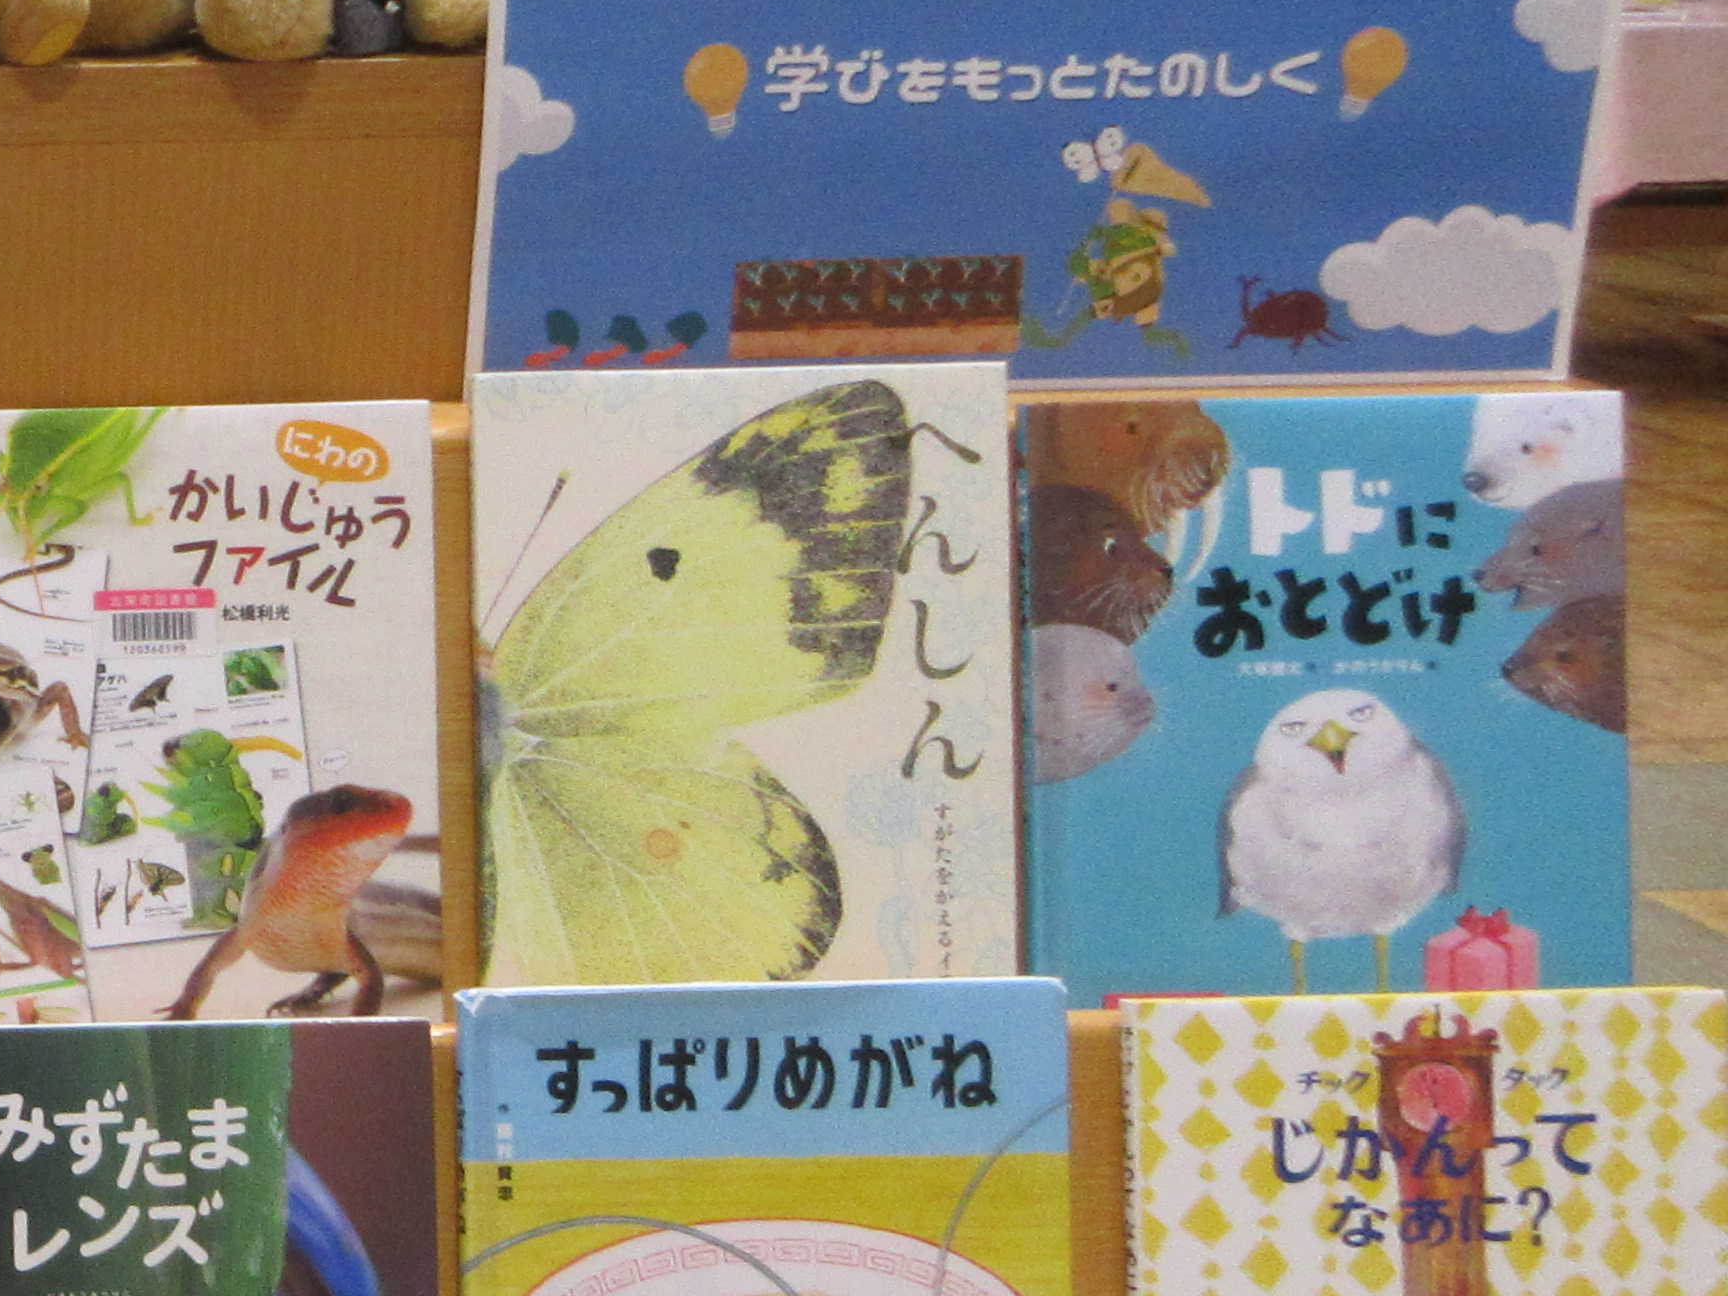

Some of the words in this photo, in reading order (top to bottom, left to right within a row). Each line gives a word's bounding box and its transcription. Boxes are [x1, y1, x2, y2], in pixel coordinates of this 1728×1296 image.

[762, 42, 1325, 112] 学びをもっとたのしく
[282, 425, 380, 474] にわの
[166, 468, 413, 550] かいじゅう
[1247, 466, 1457, 556] トドに
[171, 538, 358, 608] ファイル
[896, 420, 986, 781] へんしん
[221, 604, 291, 623] 松橋利光
[1192, 566, 1477, 660] おとどけ
[534, 1033, 999, 1116] すっぱりめがね
[1296, 1068, 1373, 1094] チック
[1502, 1067, 1571, 1090] タック
[1270, 1110, 1598, 1185] じかんって
[12, 1188, 226, 1273] レンズ
[1329, 1185, 1553, 1248] なあに?
